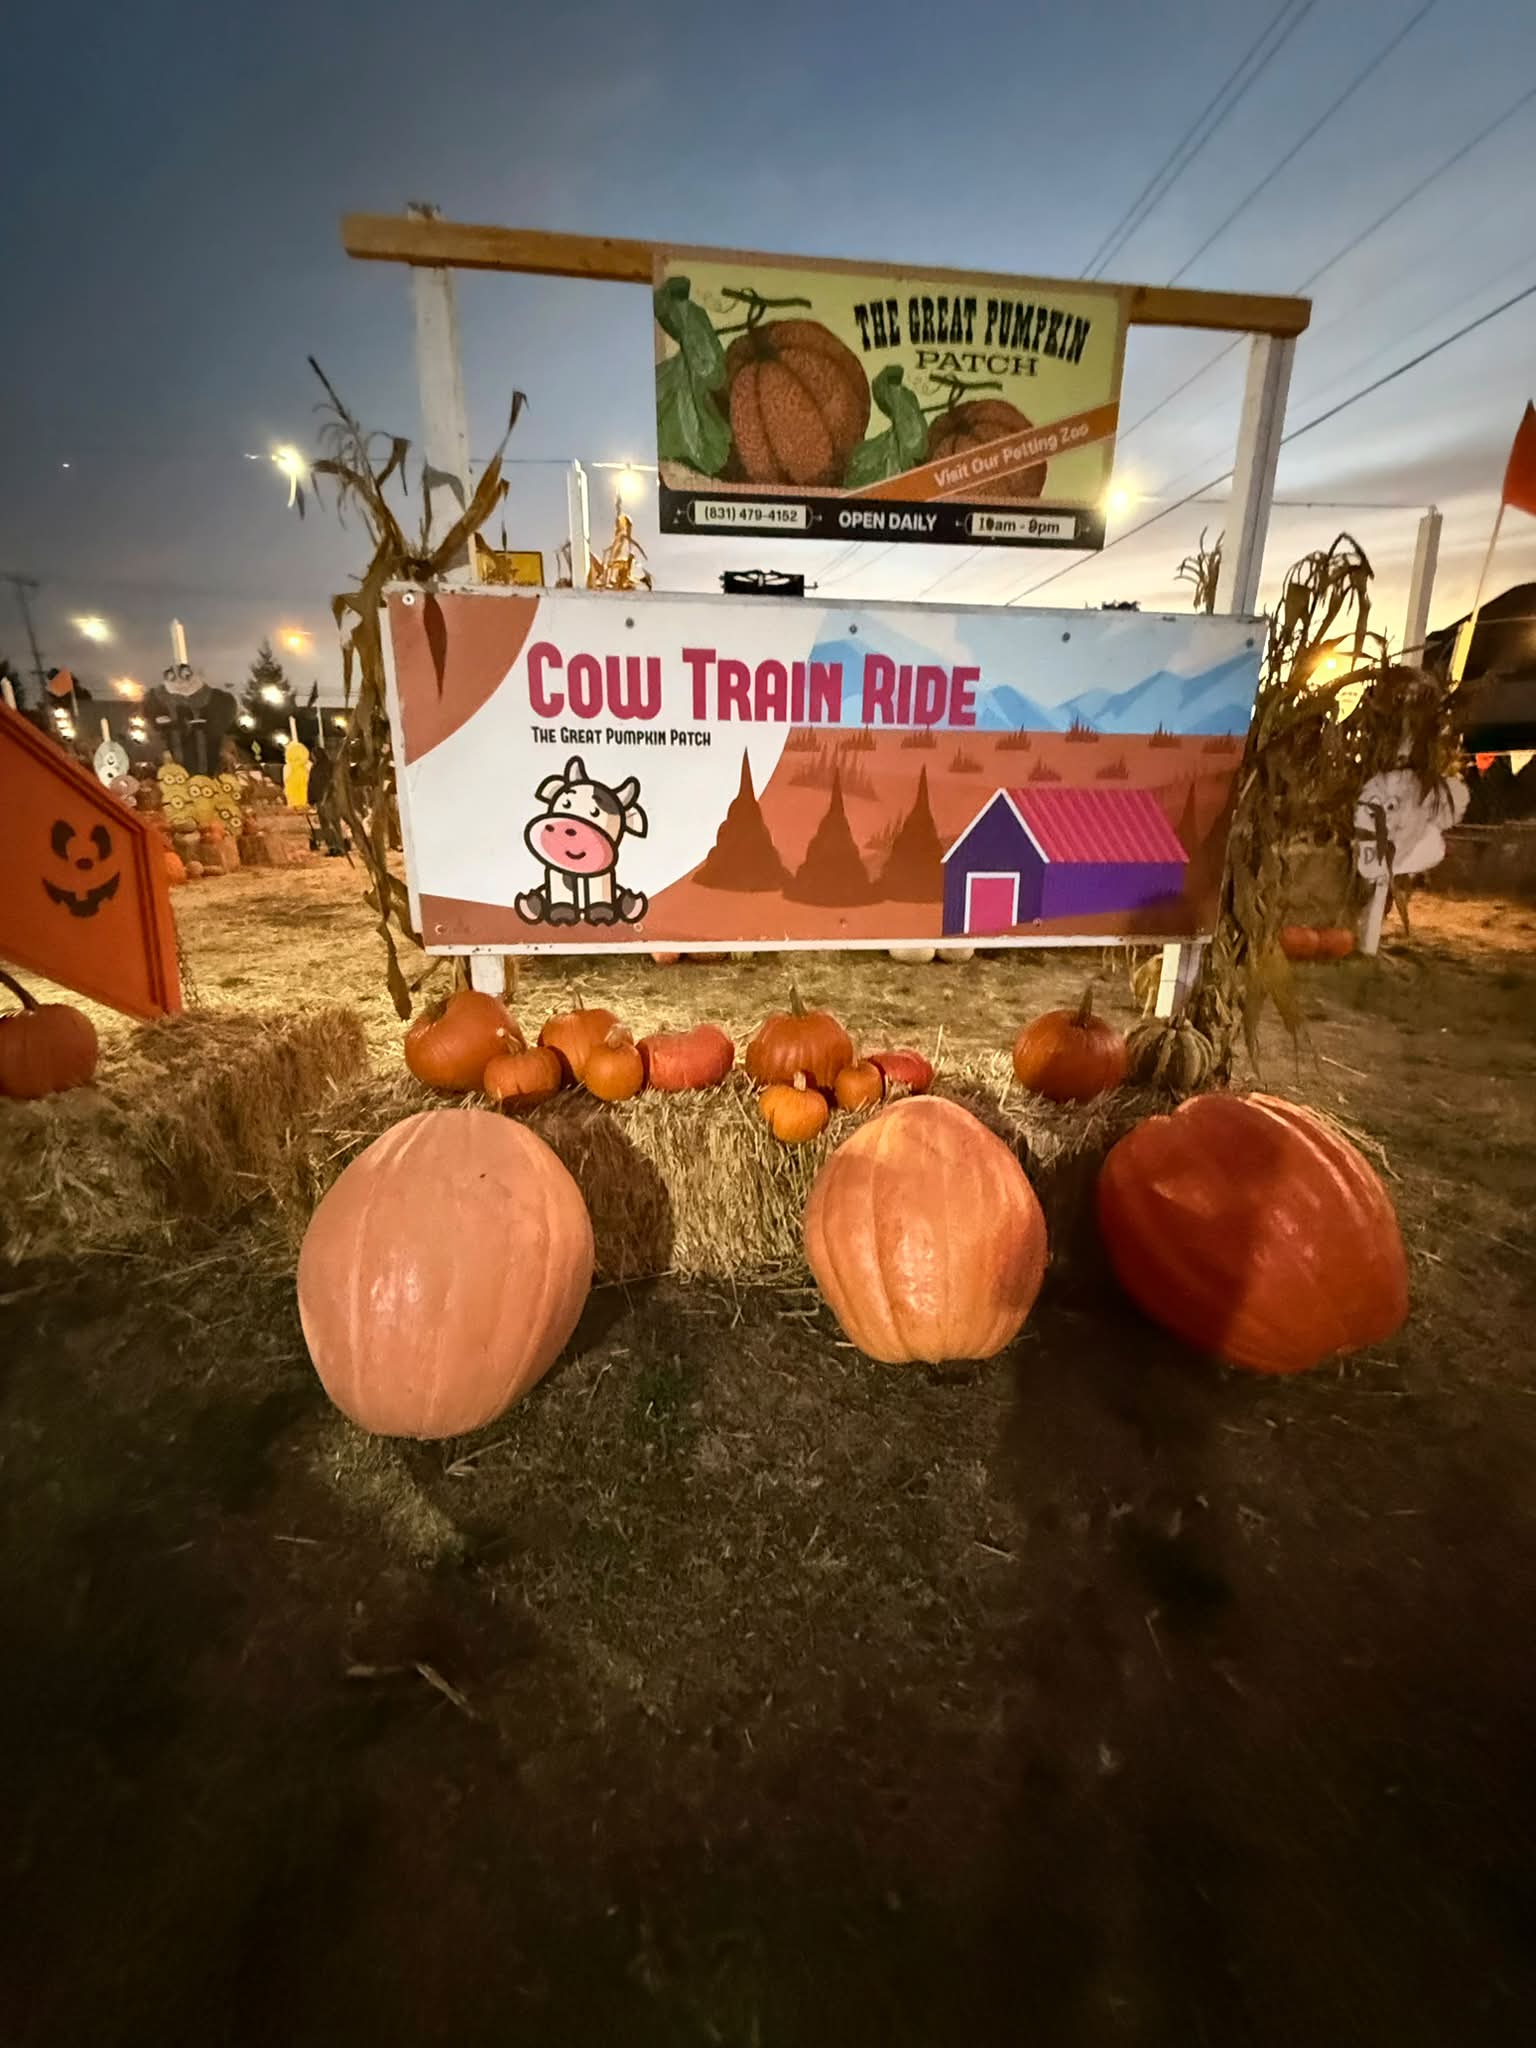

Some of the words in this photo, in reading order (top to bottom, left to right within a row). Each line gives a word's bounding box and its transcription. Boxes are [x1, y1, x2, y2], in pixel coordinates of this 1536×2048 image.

[854, 297, 901, 352] THE
[908, 296, 977, 345] GREAT
[985, 299, 1091, 366] PUMPKIN
[915, 350, 1040, 377] PATCH
[934, 463, 971, 488] Visit
[971, 453, 1001, 474] Our
[1003, 433, 1059, 465] Petting
[1059, 423, 1090, 444] Zoo
[704, 506, 736, 521] (831)
[739, 509, 798, 522] 479-4152
[838, 511, 886, 530] OPEN
[888, 513, 938, 532] DAILY
